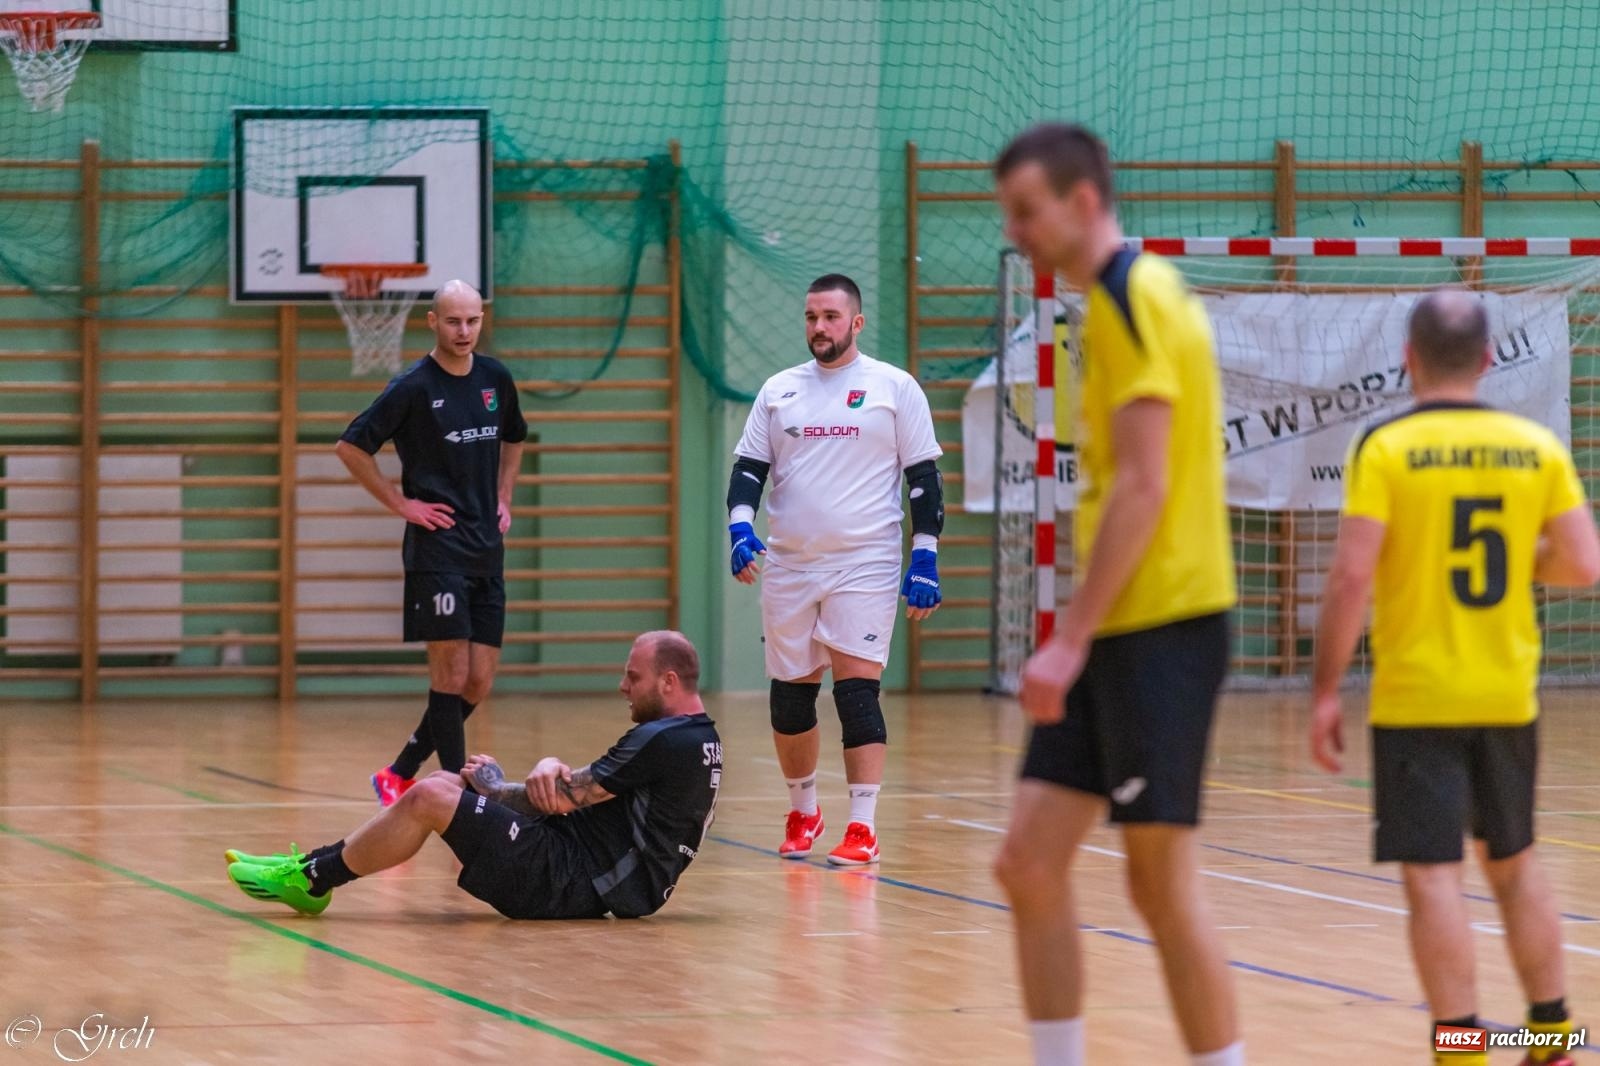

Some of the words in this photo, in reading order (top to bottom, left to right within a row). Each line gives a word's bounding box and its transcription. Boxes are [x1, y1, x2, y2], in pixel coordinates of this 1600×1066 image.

[804, 426, 859, 437] SOLIDUM
[1261, 402, 1299, 438] W
[1449, 495, 1508, 609] 5
[910, 574, 939, 588] reusch
[433, 592, 456, 615] 10
